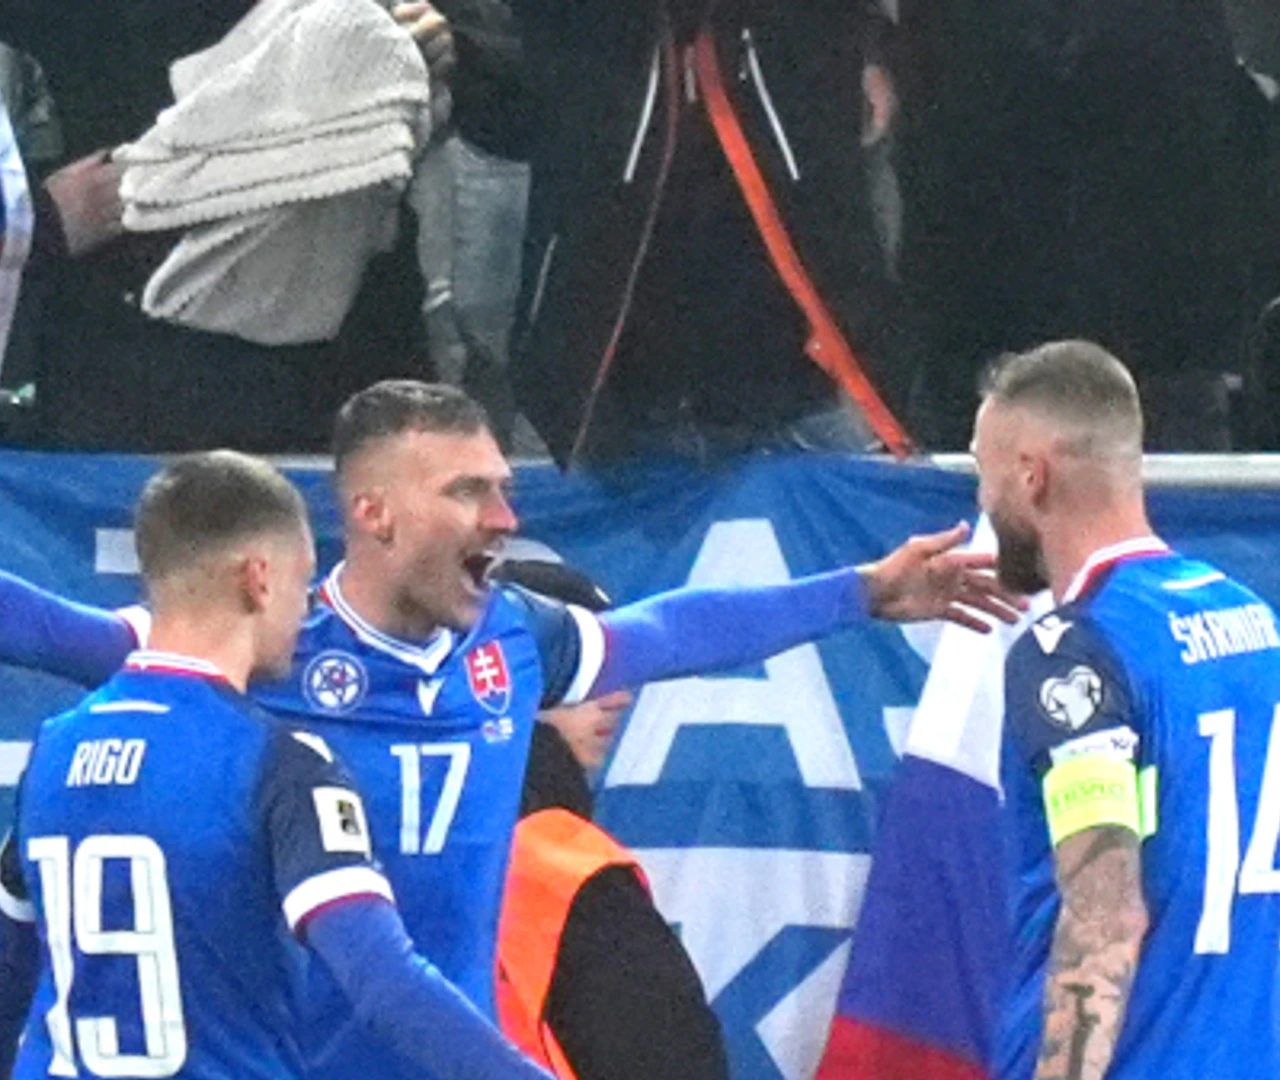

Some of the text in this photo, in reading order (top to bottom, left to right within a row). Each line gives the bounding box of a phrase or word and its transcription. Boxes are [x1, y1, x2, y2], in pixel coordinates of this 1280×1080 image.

[66, 738, 147, 787] RIGO
[389, 741, 471, 856] 17
[27, 834, 188, 1079] 19
